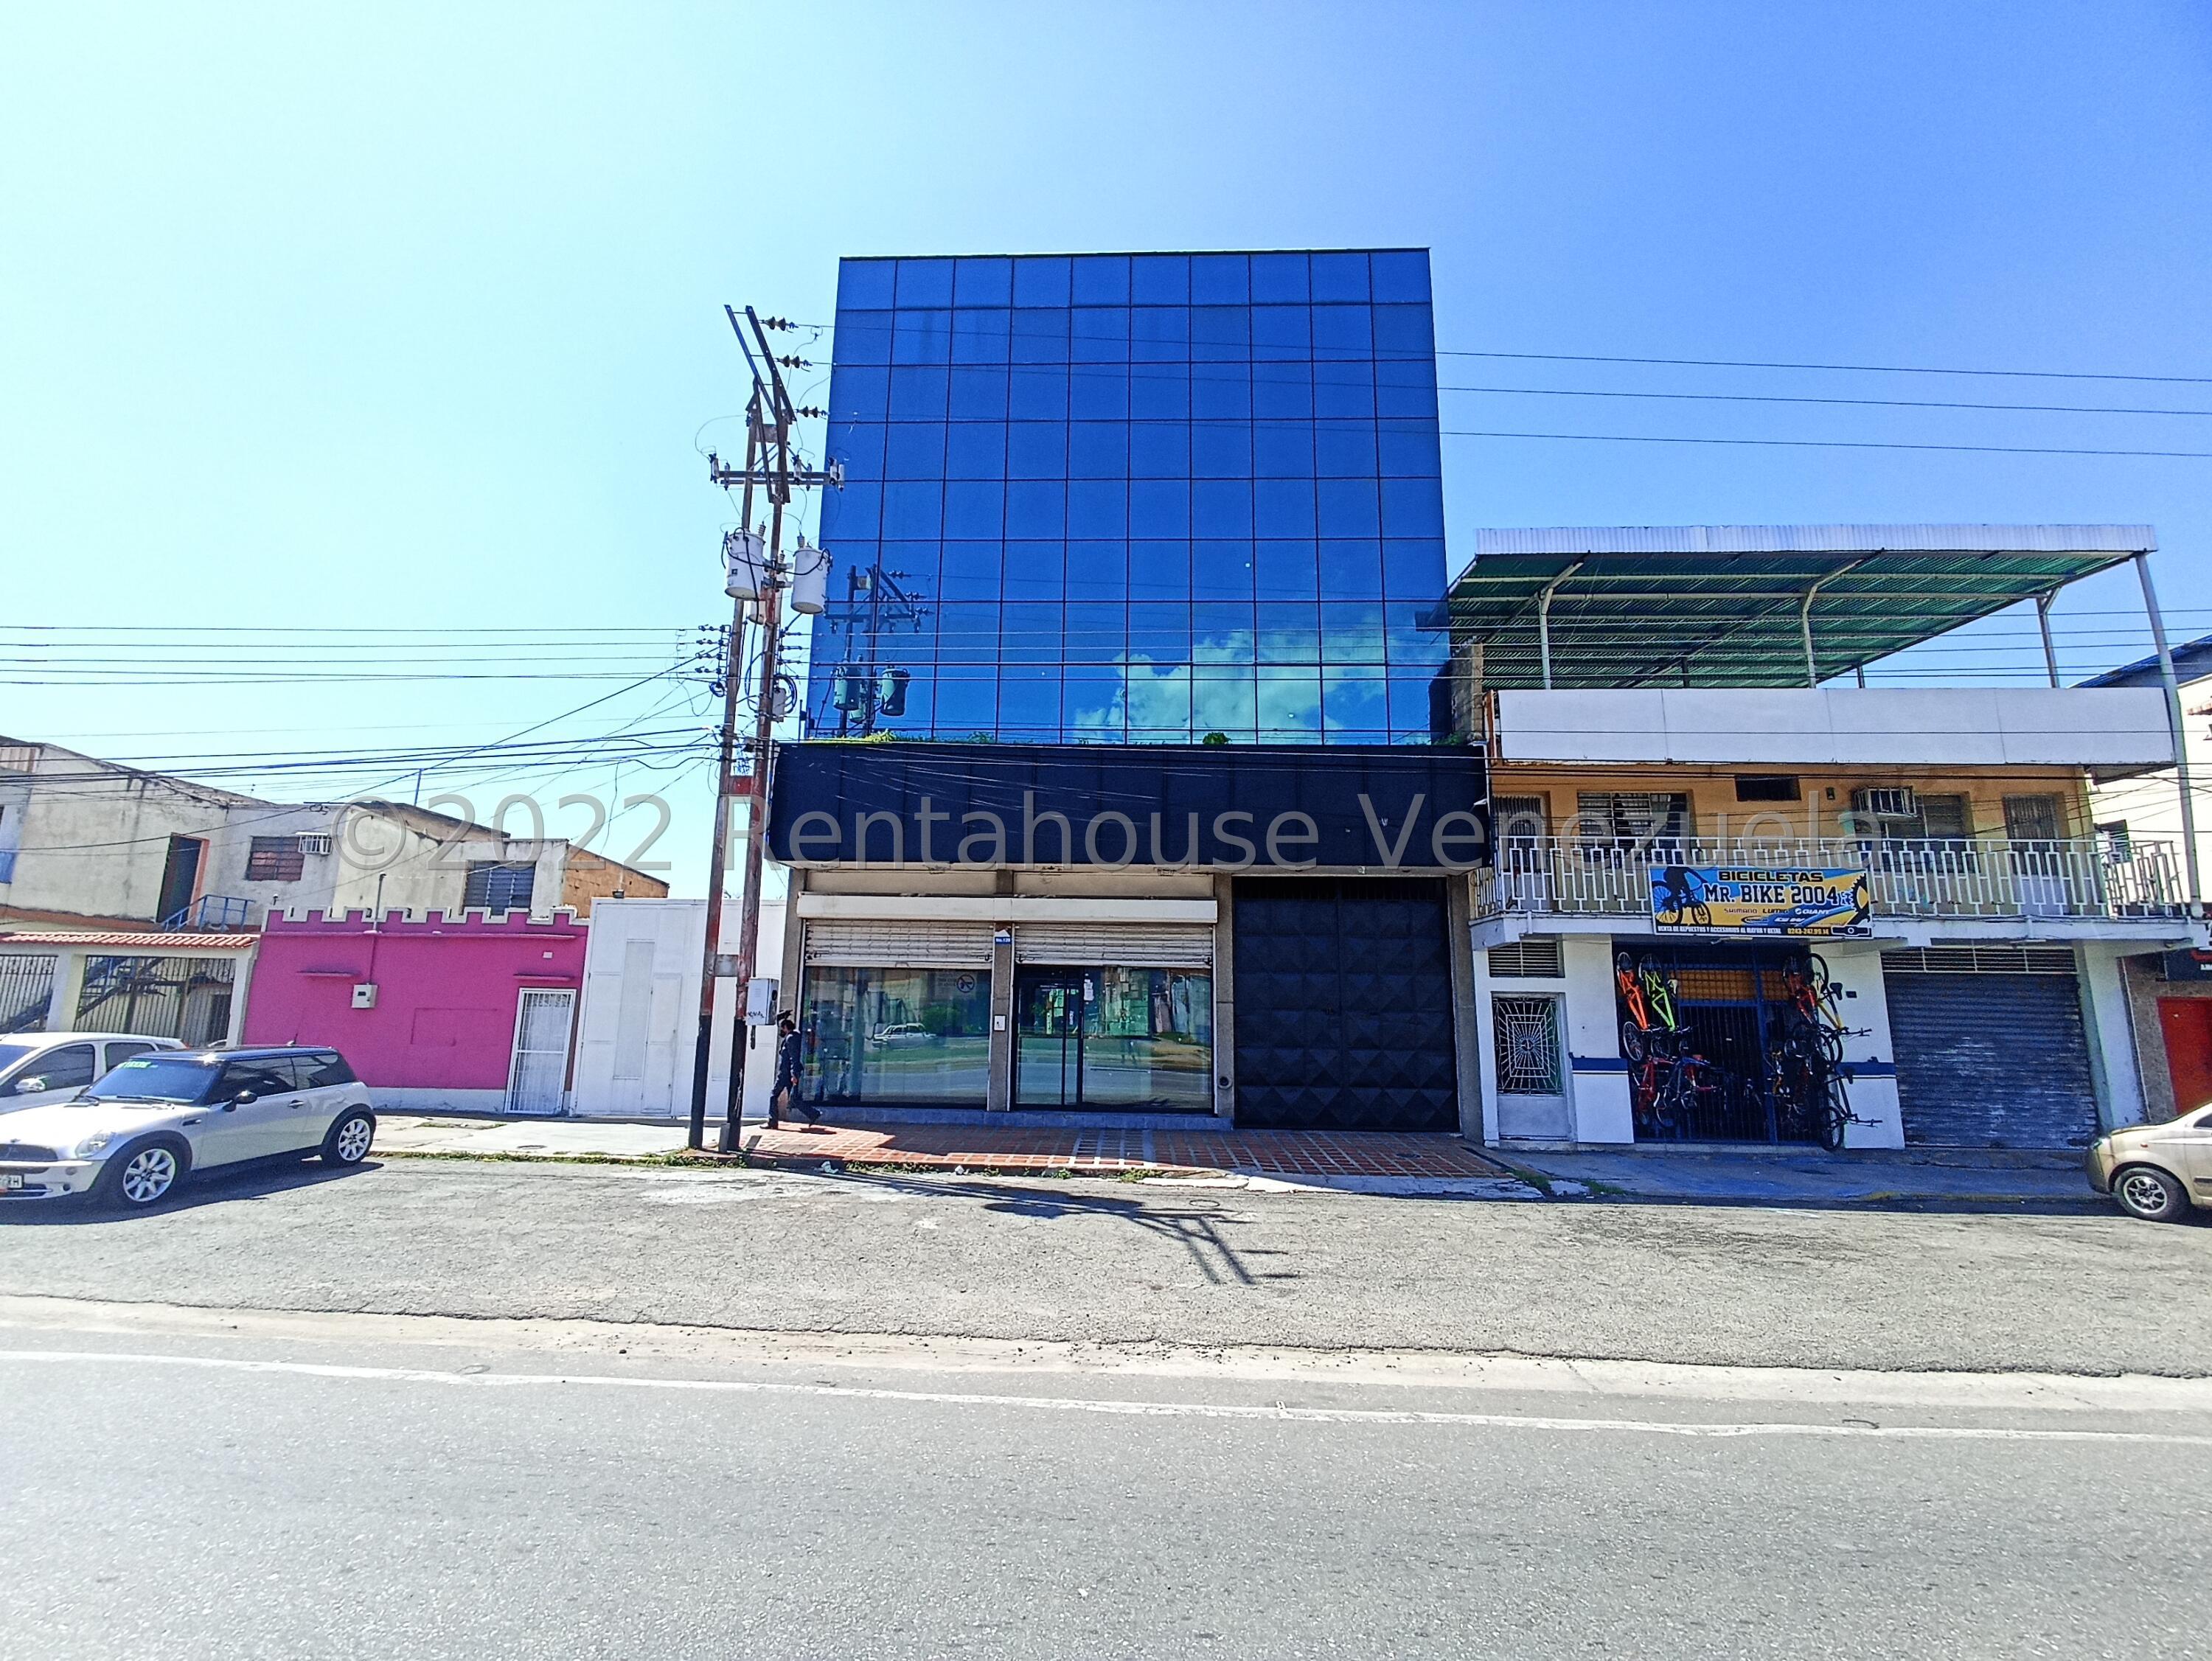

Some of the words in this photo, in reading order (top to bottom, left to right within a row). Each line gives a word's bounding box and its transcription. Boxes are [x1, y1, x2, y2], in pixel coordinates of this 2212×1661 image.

[1719, 871, 1823, 882] BICICLETAS
[1741, 885, 1784, 904] BIKE
[1791, 885, 1838, 905] 2004
